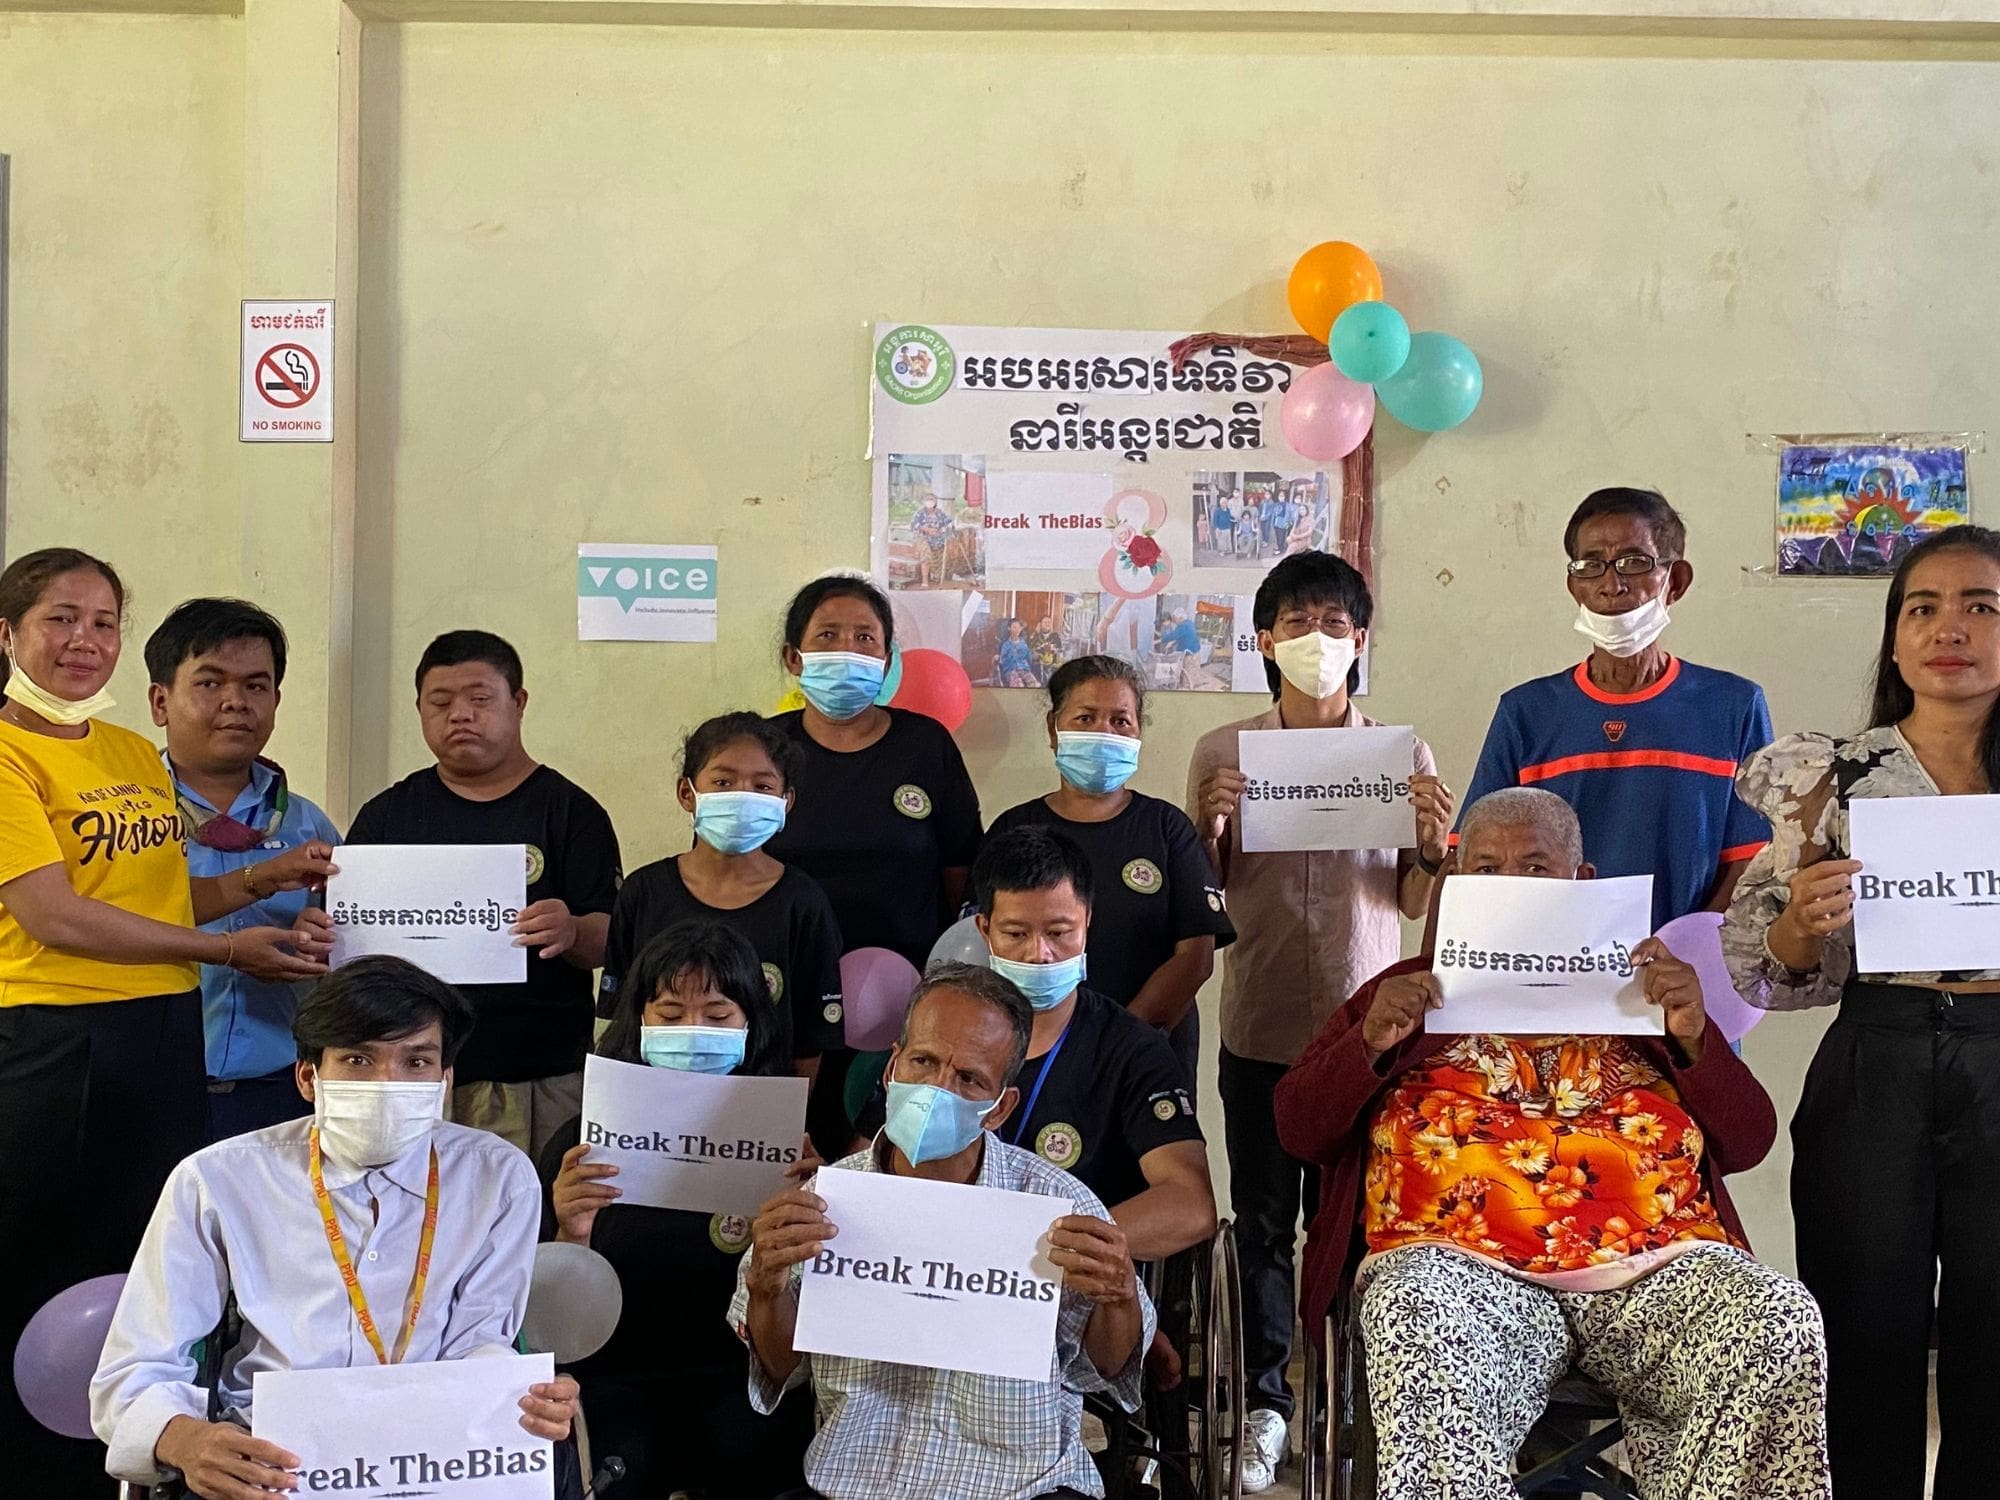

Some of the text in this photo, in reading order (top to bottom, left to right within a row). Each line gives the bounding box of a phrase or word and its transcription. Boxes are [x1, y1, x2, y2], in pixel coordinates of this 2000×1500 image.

[252, 421, 321, 430] NO SMOKING
[1010, 401, 1262, 462] នារីអន្តរជាតិ
[985, 513, 1103, 529] Break TheBias
[71, 810, 188, 866] History
[1859, 872, 1957, 899] Break
[586, 1121, 798, 1164] Break TheBias
[341, 1263, 357, 1287] PPIU
[811, 1248, 1056, 1302] Break TheBias
[358, 1309, 374, 1333] PPIU
[390, 1446, 548, 1485] TheBias
